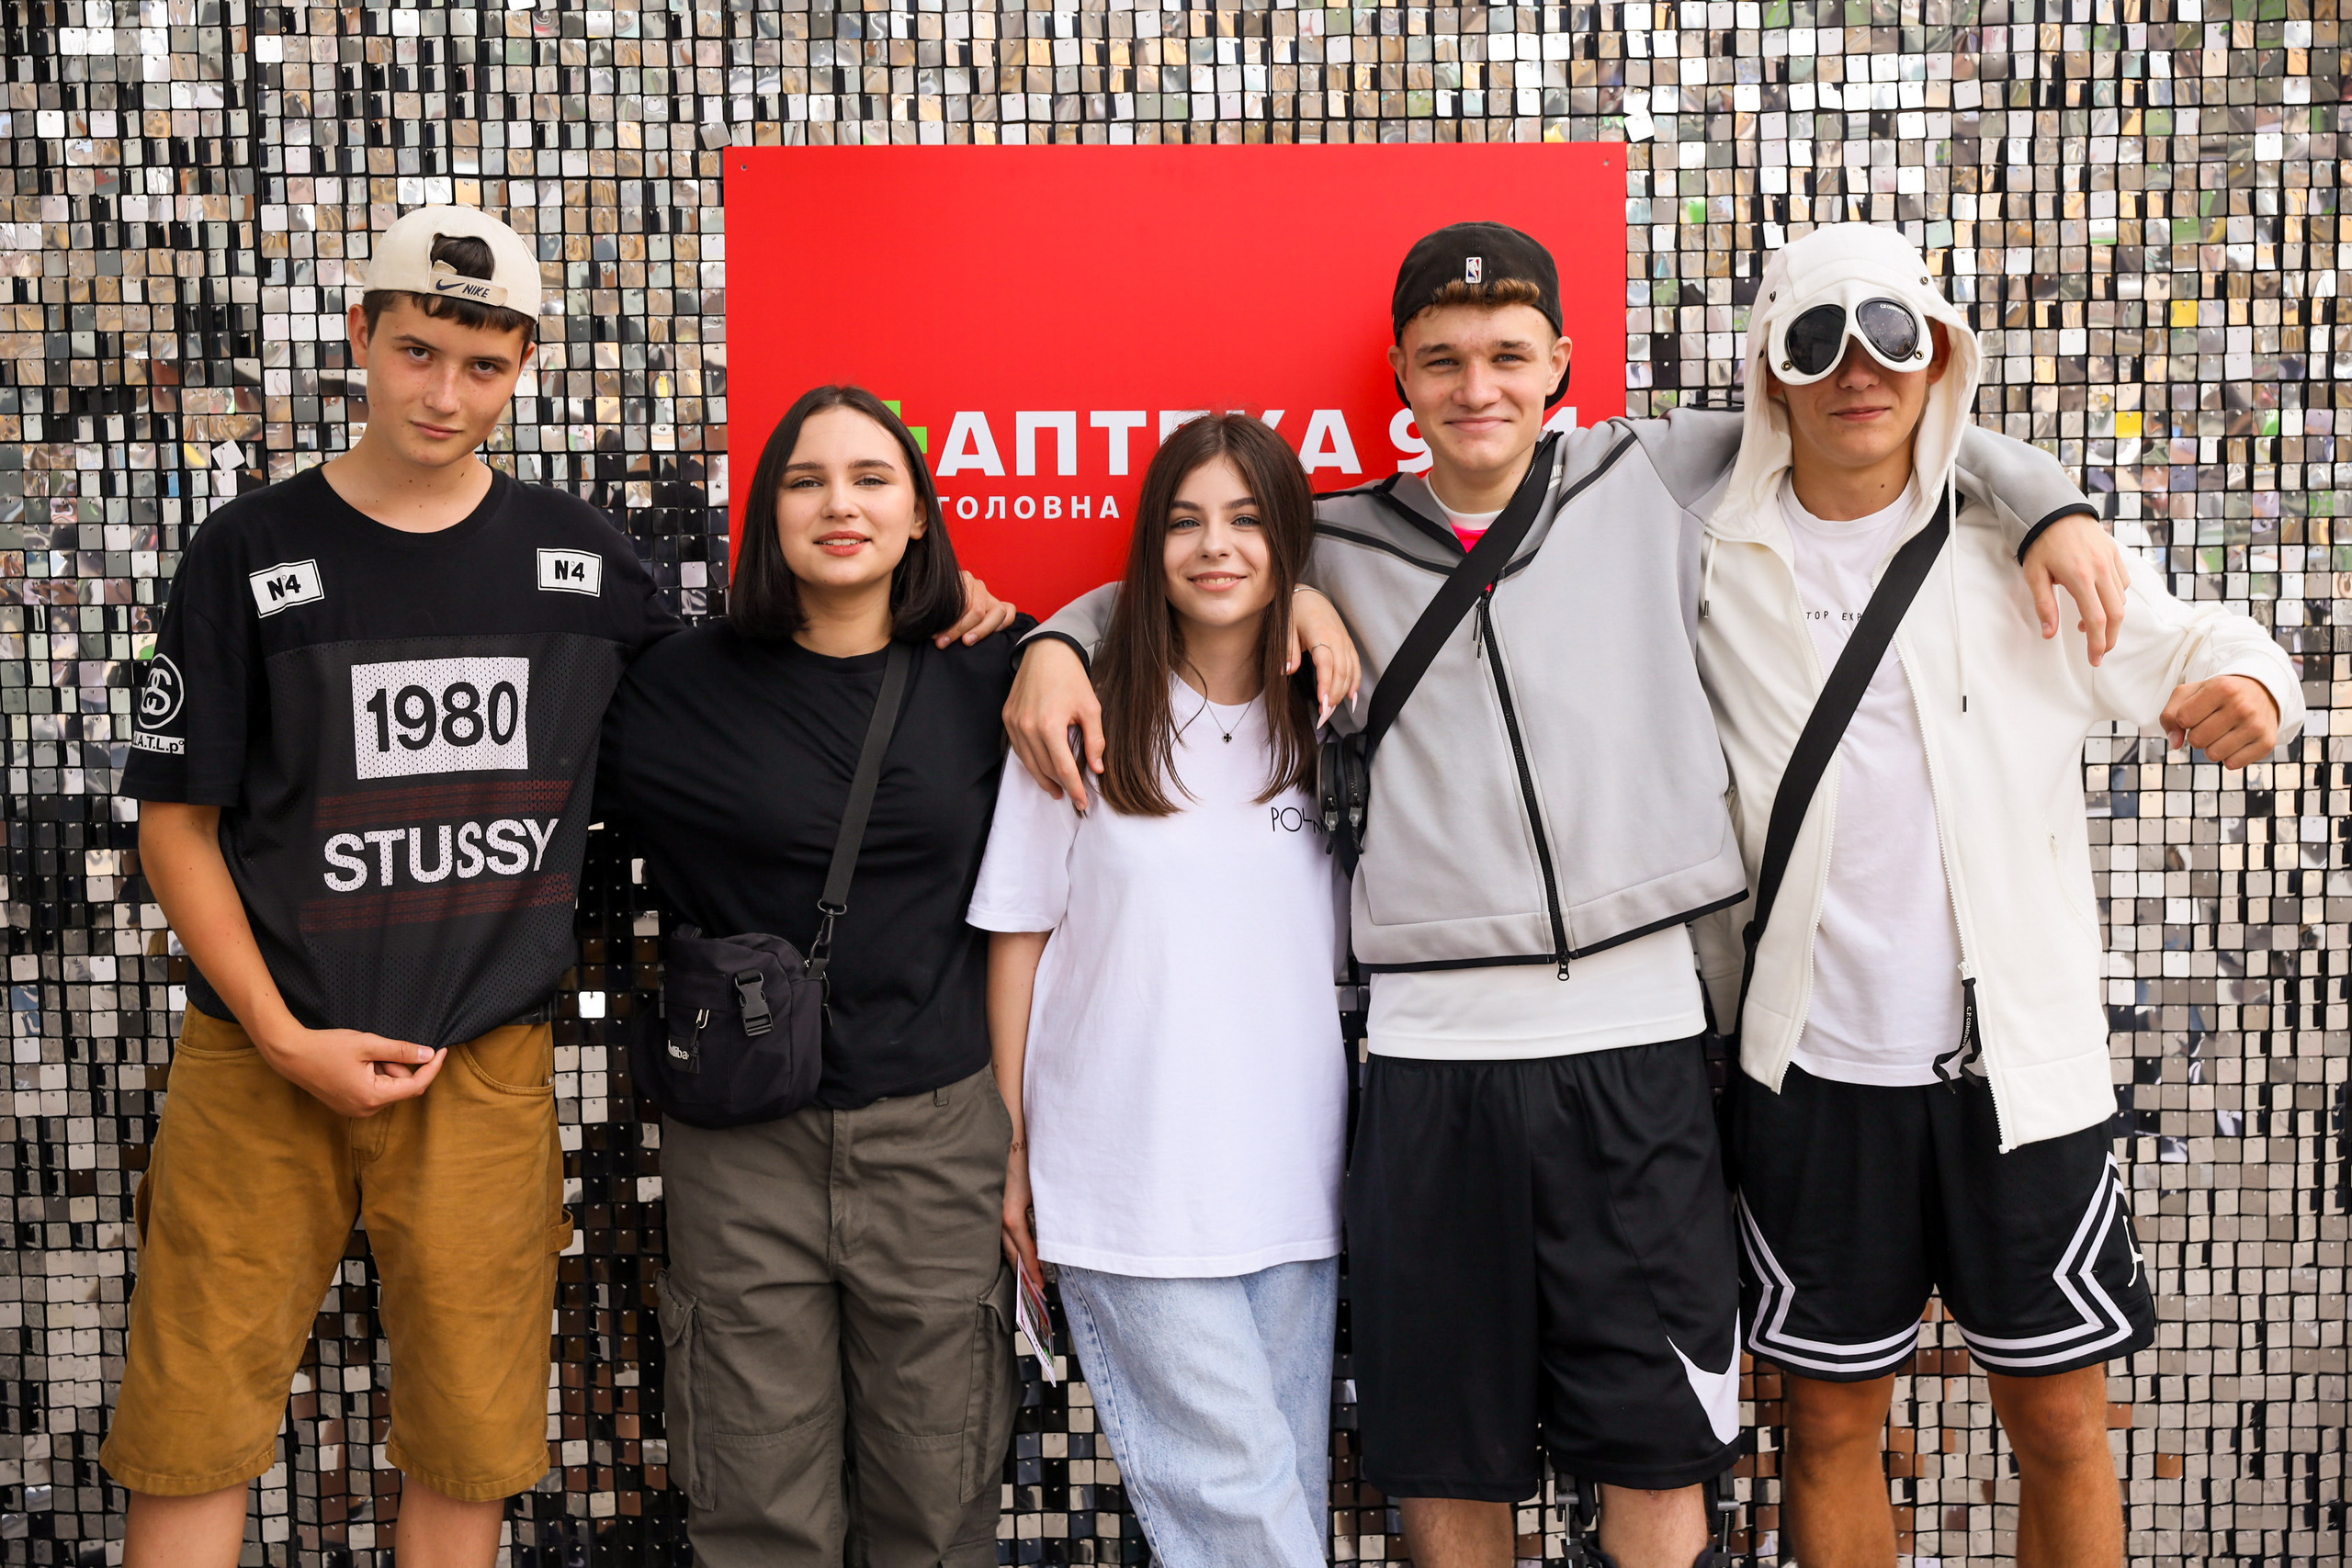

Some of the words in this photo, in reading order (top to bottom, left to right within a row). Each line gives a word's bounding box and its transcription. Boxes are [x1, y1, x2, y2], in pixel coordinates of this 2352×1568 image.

[461, 284, 491, 299] NIKE
[935, 409, 1363, 476] АПТА
[1806, 610, 1829, 620] TOP
[367, 681, 519, 752] 1980
[323, 818, 560, 892] STUSSY
